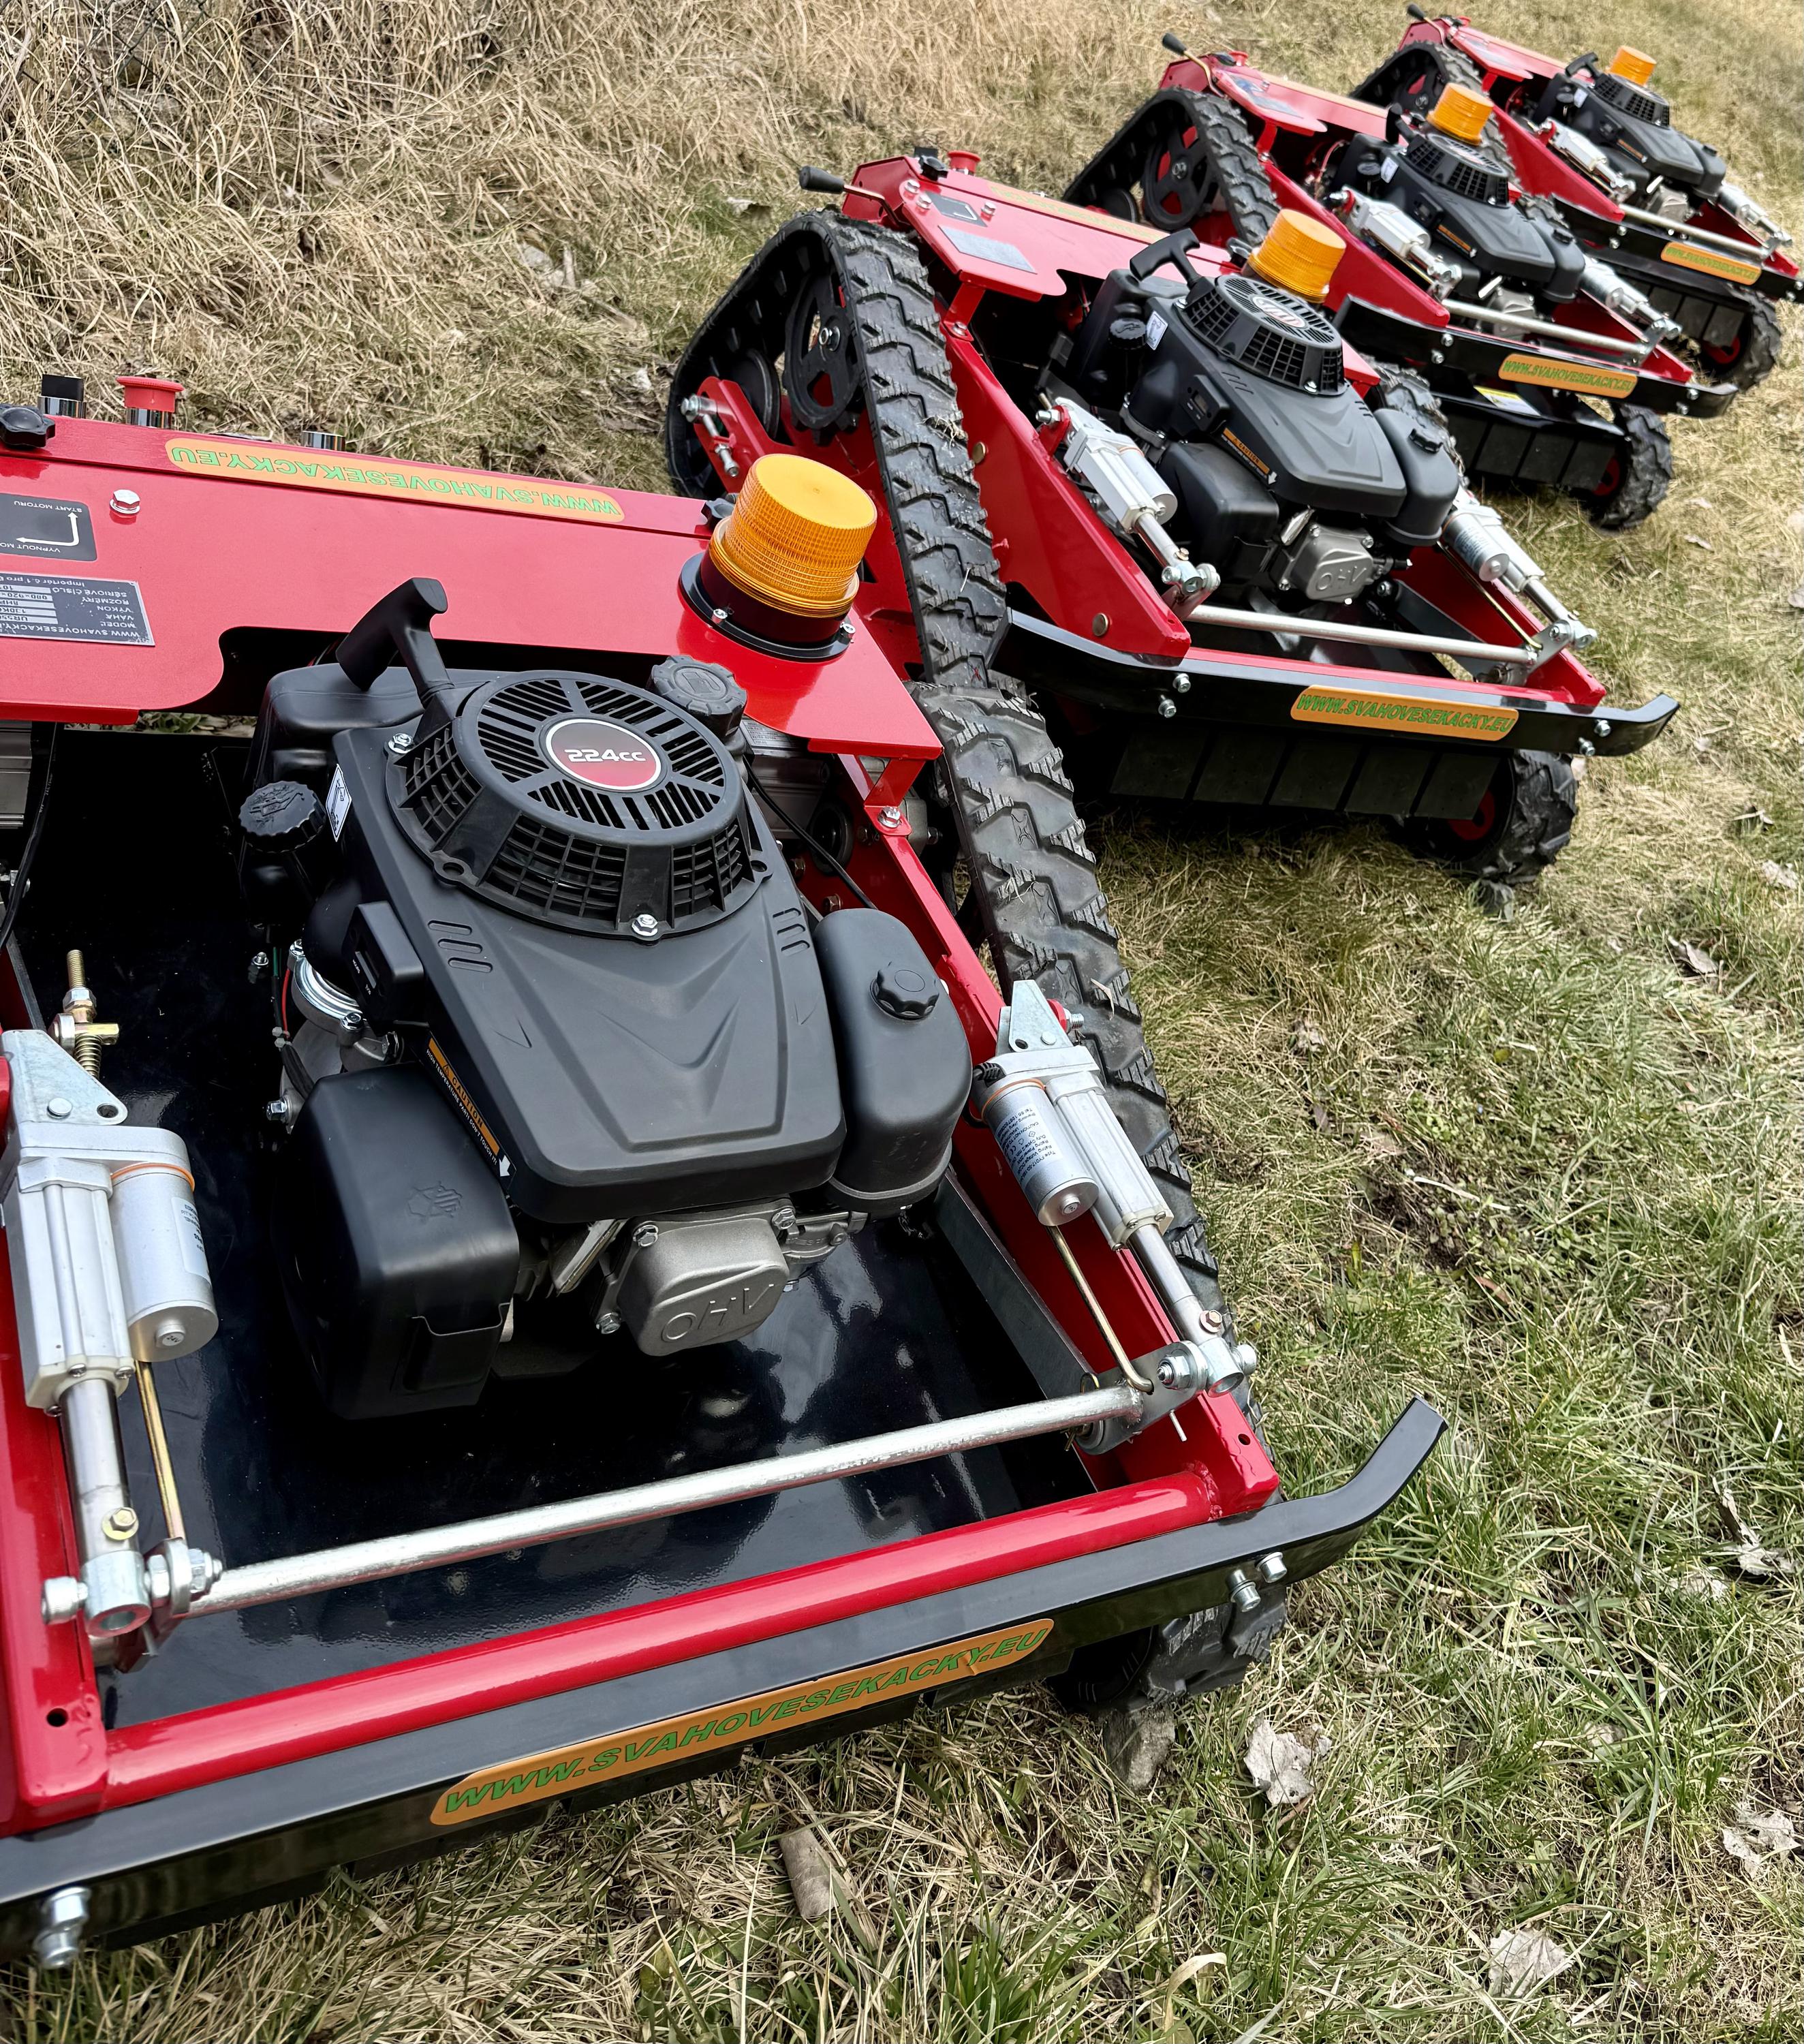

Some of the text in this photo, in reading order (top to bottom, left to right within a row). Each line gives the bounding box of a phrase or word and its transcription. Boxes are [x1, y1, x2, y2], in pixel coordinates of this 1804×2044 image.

[172, 448, 621, 516] WWW.SVAHOVESEKACKY.EU
[14, 501, 52, 509] MOTORU
[0, 623, 140, 637] WWW.SVAHOVESEKACKY.
[1296, 694, 1515, 732] WWW.SVAHOVESEKACKY.EU
[563, 749, 647, 762] 224cc
[452, 1078, 483, 1126] CAUTION
[661, 1284, 775, 1344] OHV
[445, 1629, 1048, 1813] WWW.SVAHOVESEKACKY.EU
